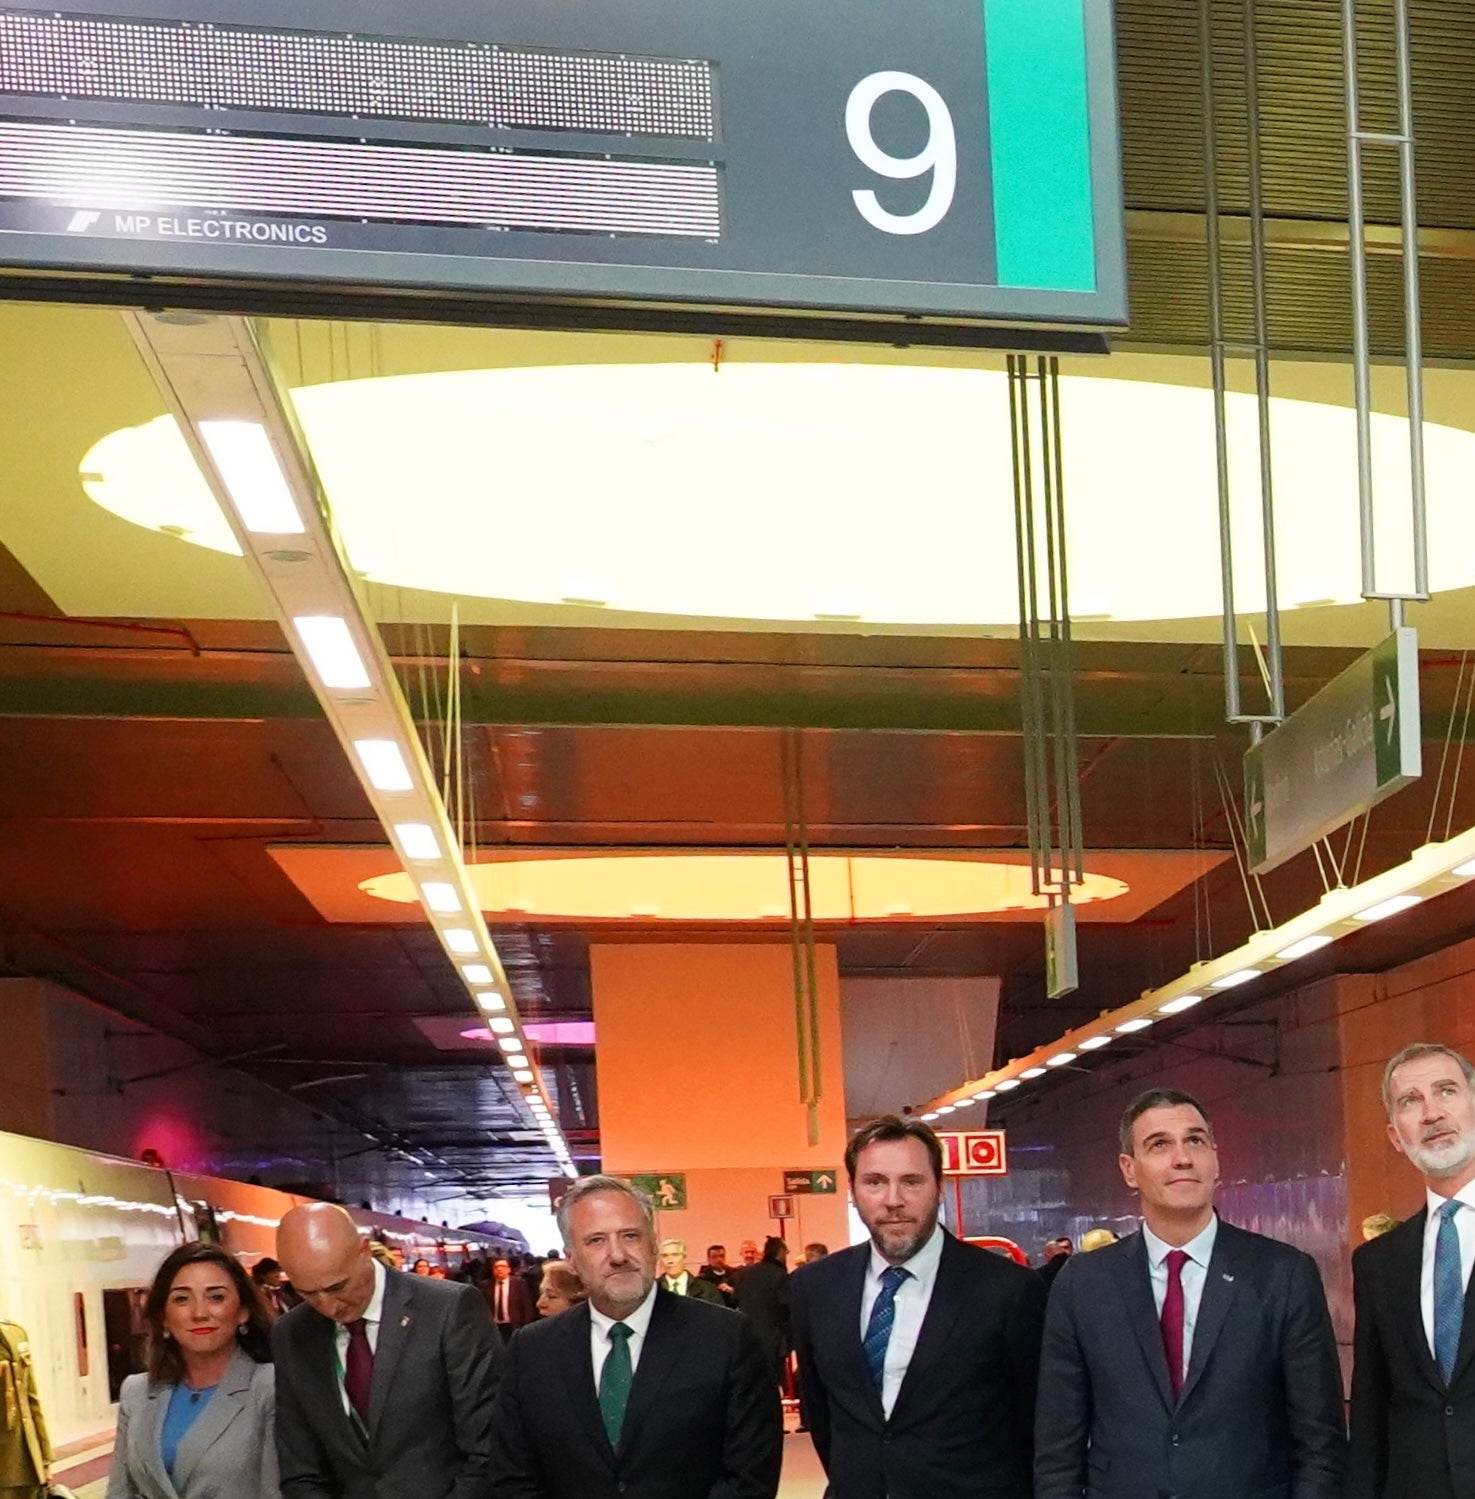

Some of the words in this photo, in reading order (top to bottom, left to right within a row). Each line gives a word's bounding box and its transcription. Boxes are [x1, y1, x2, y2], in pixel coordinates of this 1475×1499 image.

[844, 70, 958, 236] 9
[114, 214, 150, 233] MP
[157, 217, 328, 244] ELECTRONICS
